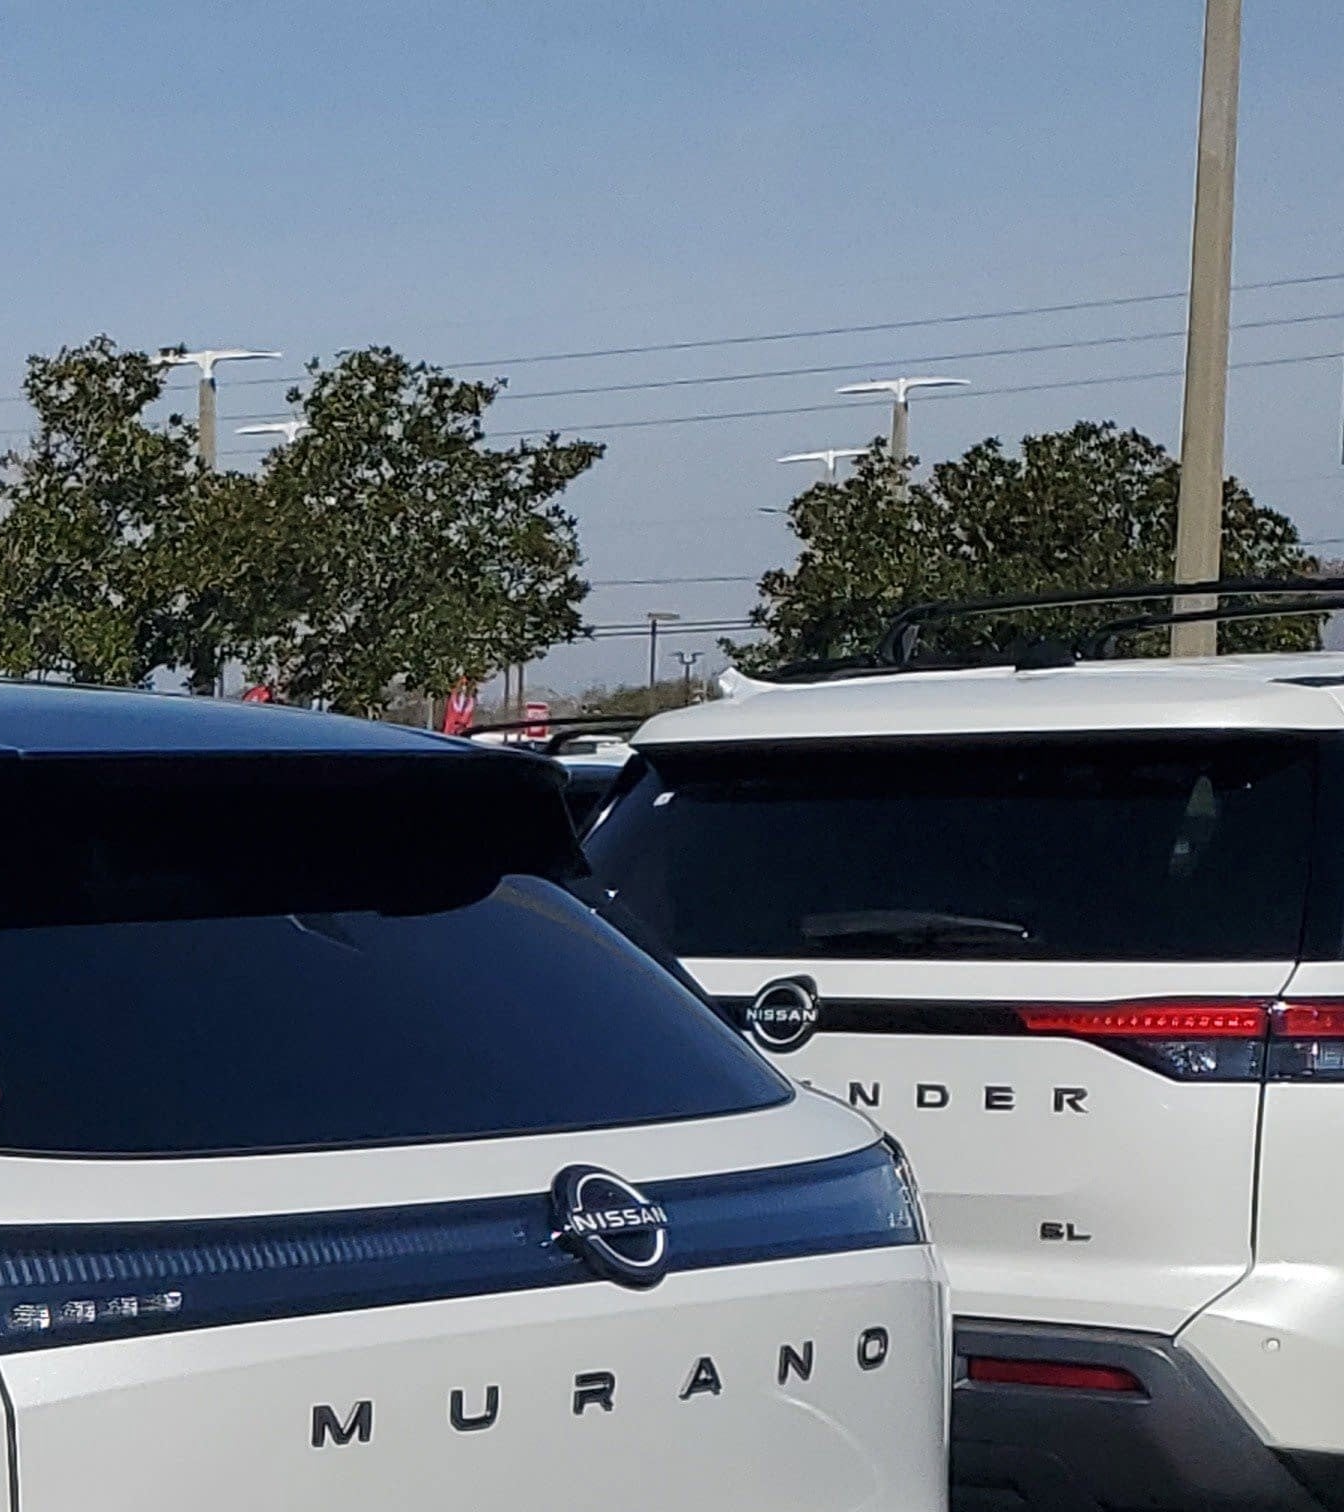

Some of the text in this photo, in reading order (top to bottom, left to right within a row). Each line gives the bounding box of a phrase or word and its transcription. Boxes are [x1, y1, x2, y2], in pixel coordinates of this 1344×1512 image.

[746, 1008, 817, 1021] NISSAN
[572, 1206, 668, 1231] NISSAN
[1039, 1222, 1092, 1241] SL
[311, 1326, 889, 1448] MURANO
